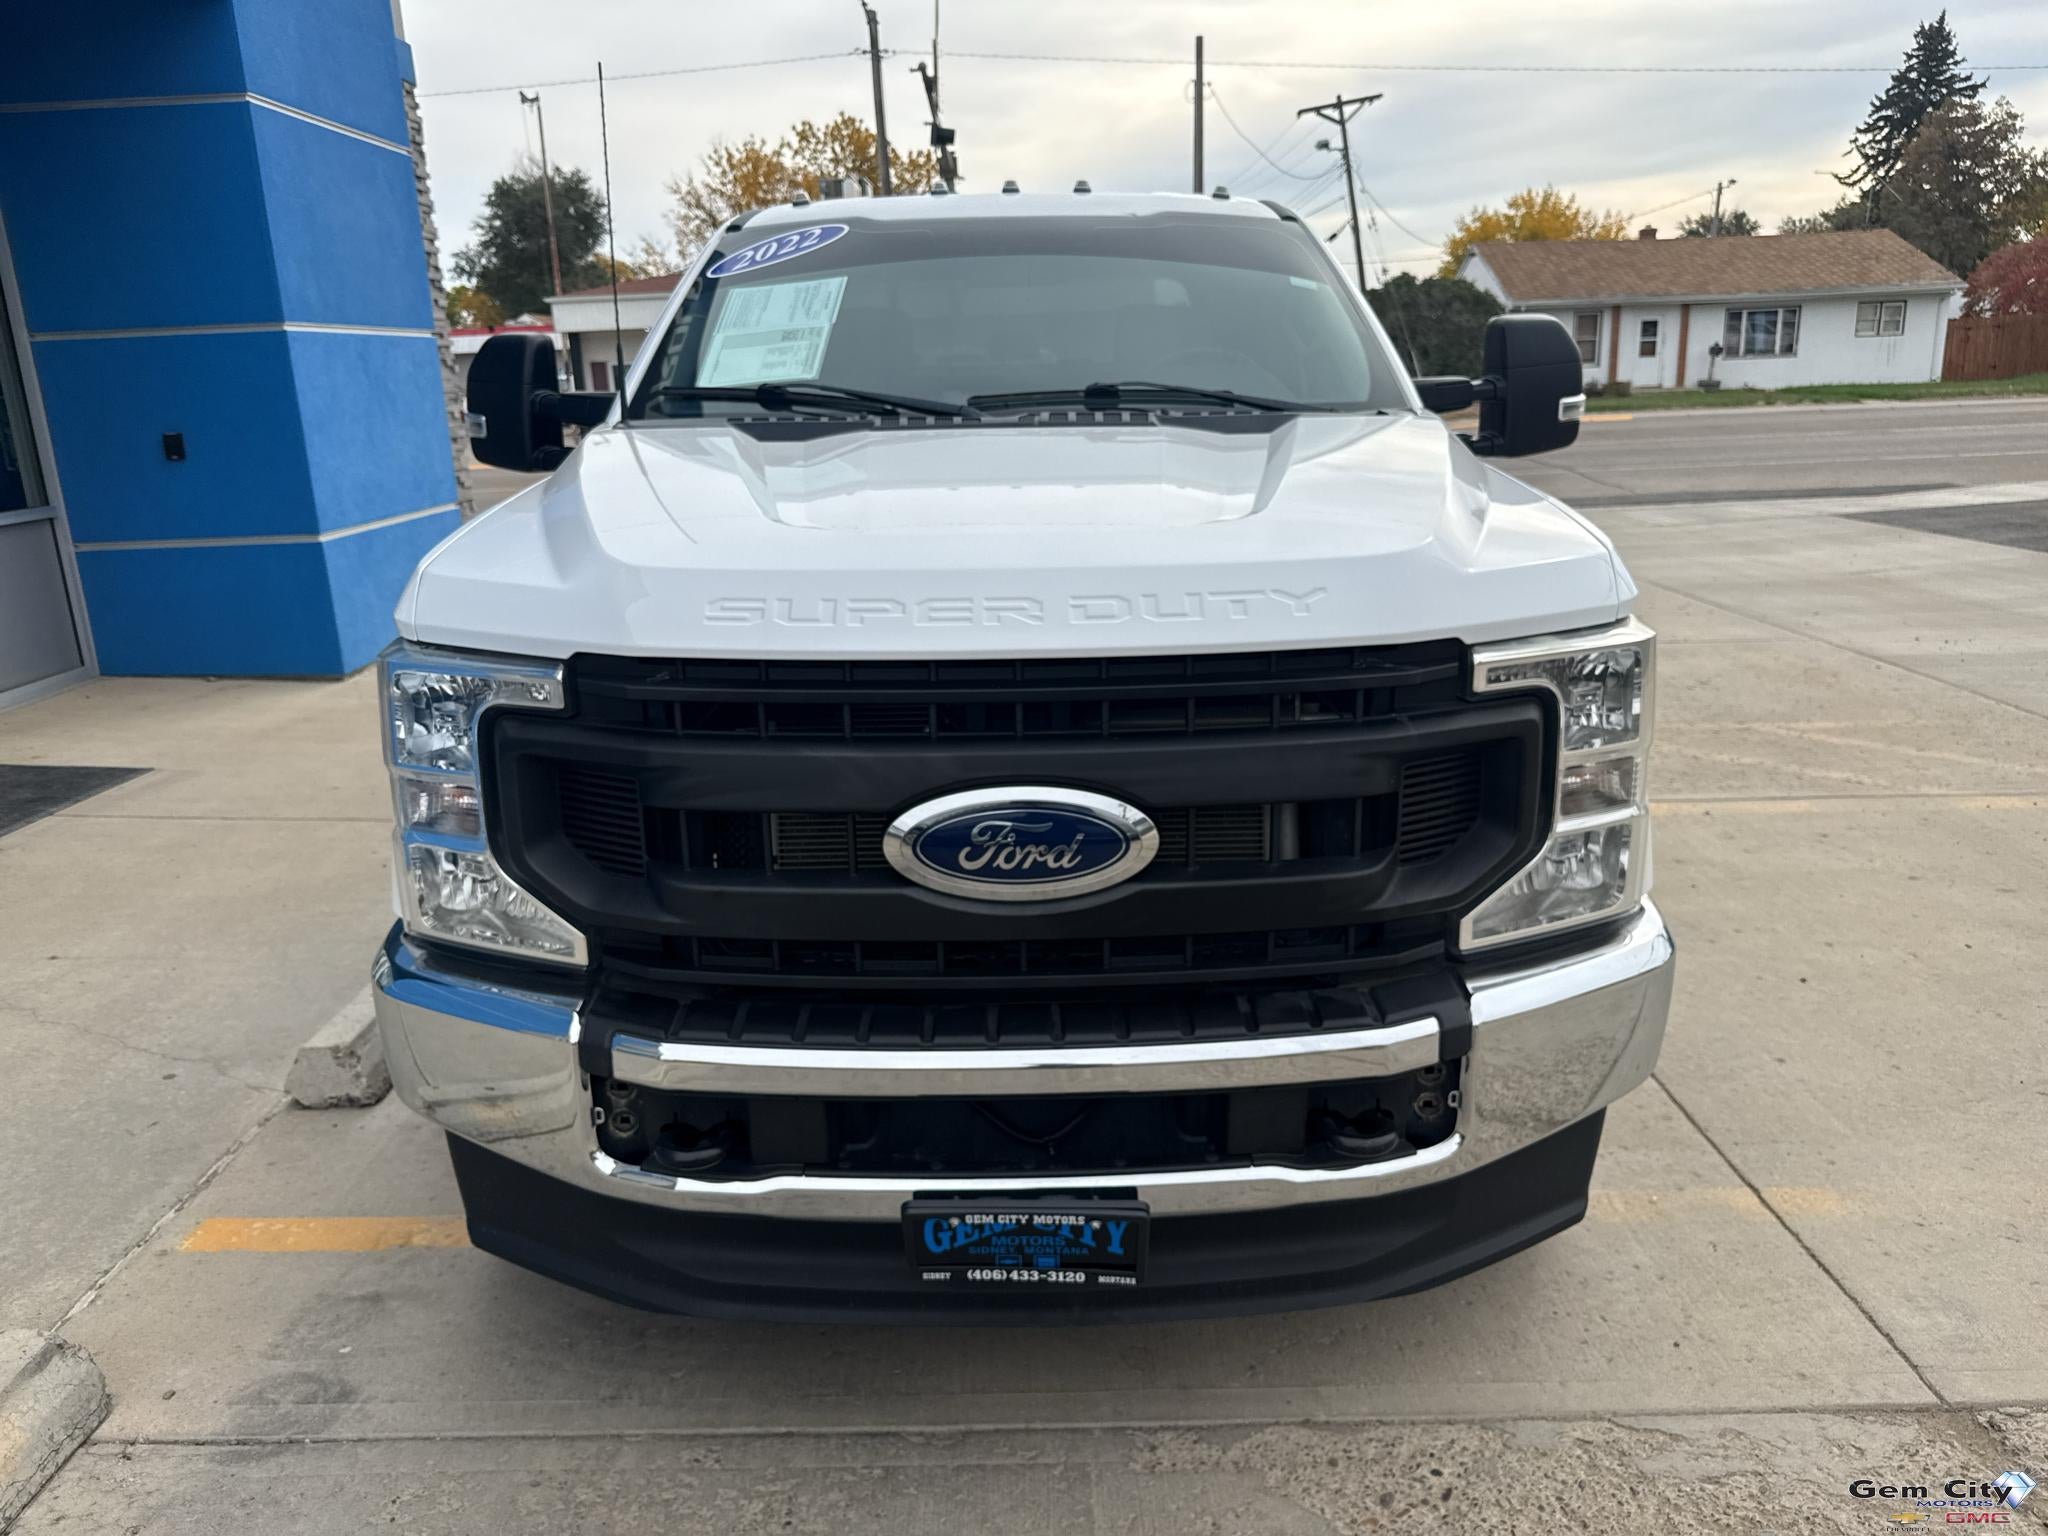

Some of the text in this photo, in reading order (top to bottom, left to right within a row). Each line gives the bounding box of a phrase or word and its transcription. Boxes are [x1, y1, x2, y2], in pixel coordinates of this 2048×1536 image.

[731, 228, 823, 272] 2022
[703, 586, 1327, 628] SUPER DUTY
[958, 820, 1086, 871] Ford
[965, 1214, 1086, 1226] GEM CITY MOTORS
[991, 1235, 1067, 1246] MOTORS
